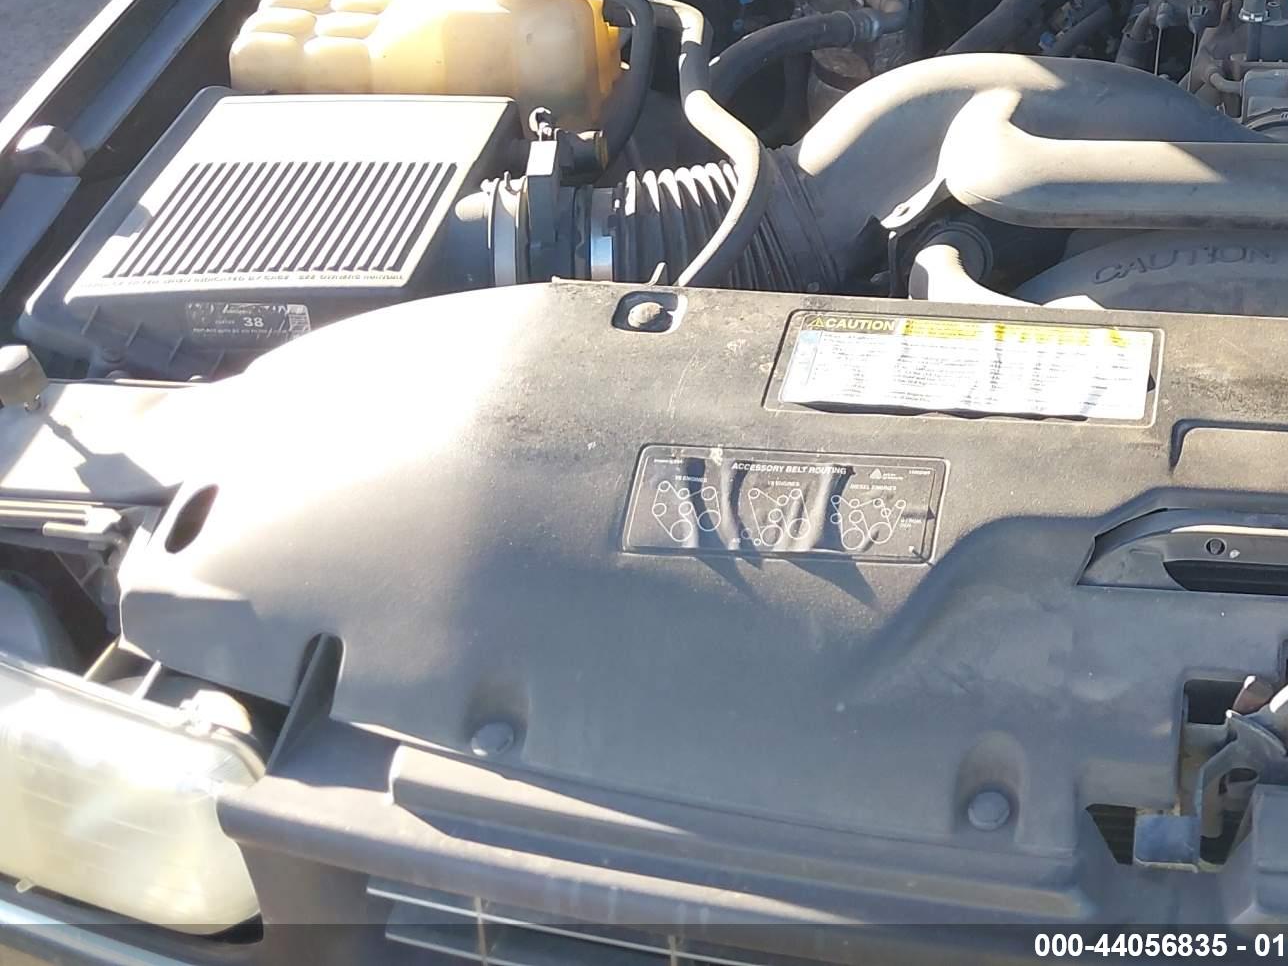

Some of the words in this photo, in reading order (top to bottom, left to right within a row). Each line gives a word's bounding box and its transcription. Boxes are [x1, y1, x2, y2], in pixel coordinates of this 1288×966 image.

[1092, 243, 1276, 285] CAUTION
[243, 317, 264, 328] 38
[825, 317, 896, 331] CAUTION
[731, 462, 785, 473] ACCESSORY
[786, 465, 808, 474] BELT
[808, 466, 848, 476] ROUTING
